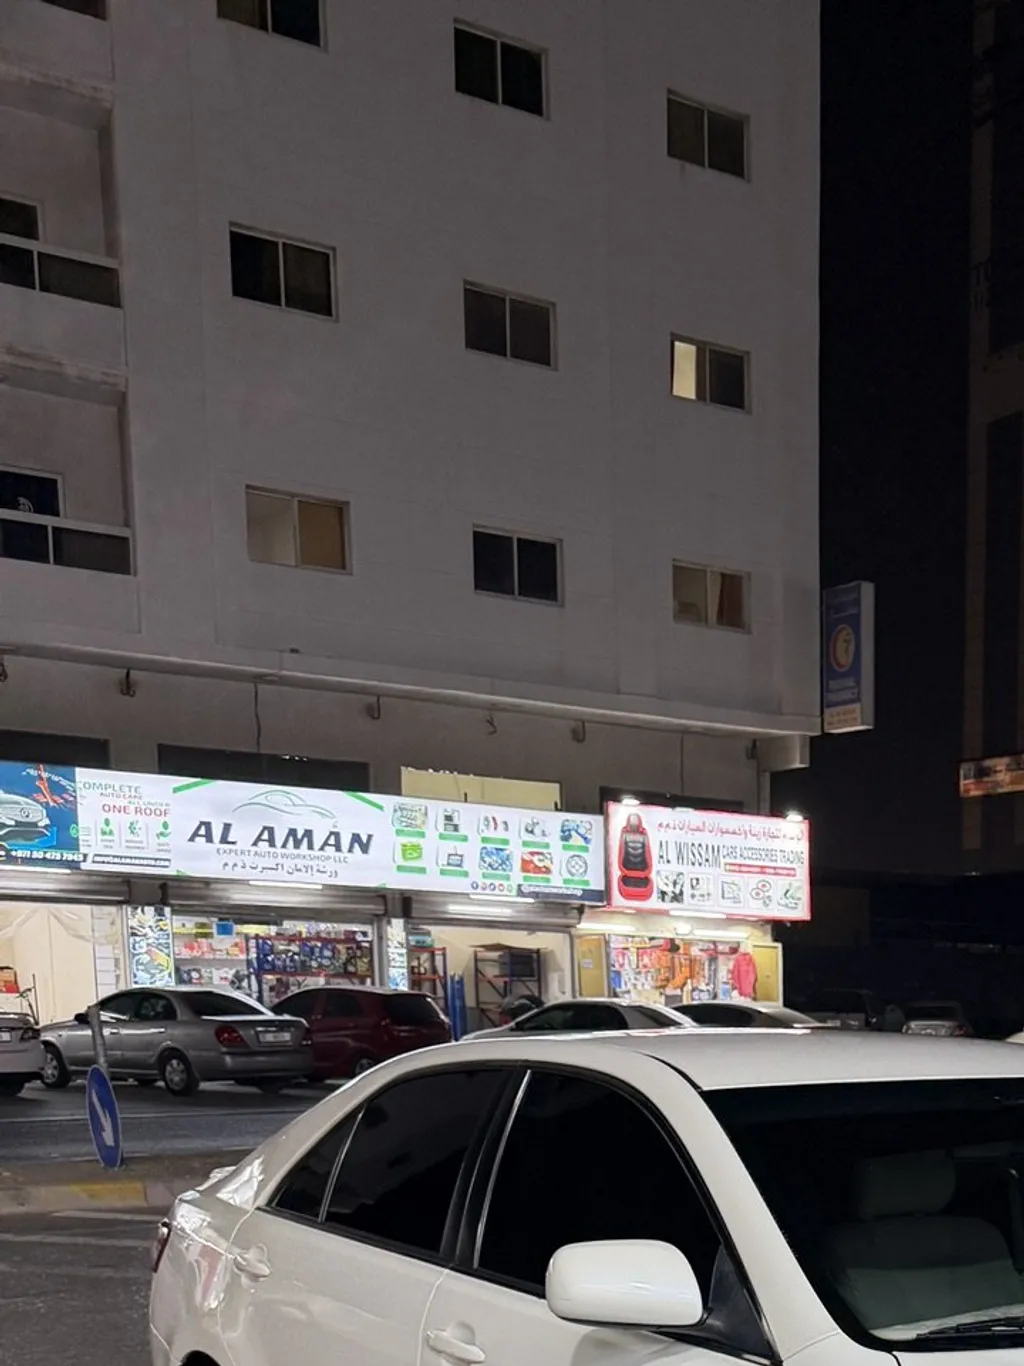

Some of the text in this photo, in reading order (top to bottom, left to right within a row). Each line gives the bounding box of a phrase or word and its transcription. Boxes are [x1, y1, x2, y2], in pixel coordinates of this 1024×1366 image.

[102, 803, 172, 818] ONE ROOF
[188, 820, 374, 855] AL AMAN
[216, 847, 251, 857] EXPERT
[253, 849, 279, 859] AUTO
[280, 852, 332, 862] WORKSHOP
[658, 839, 671, 864] AL
[674, 840, 721, 868] WISSAM
